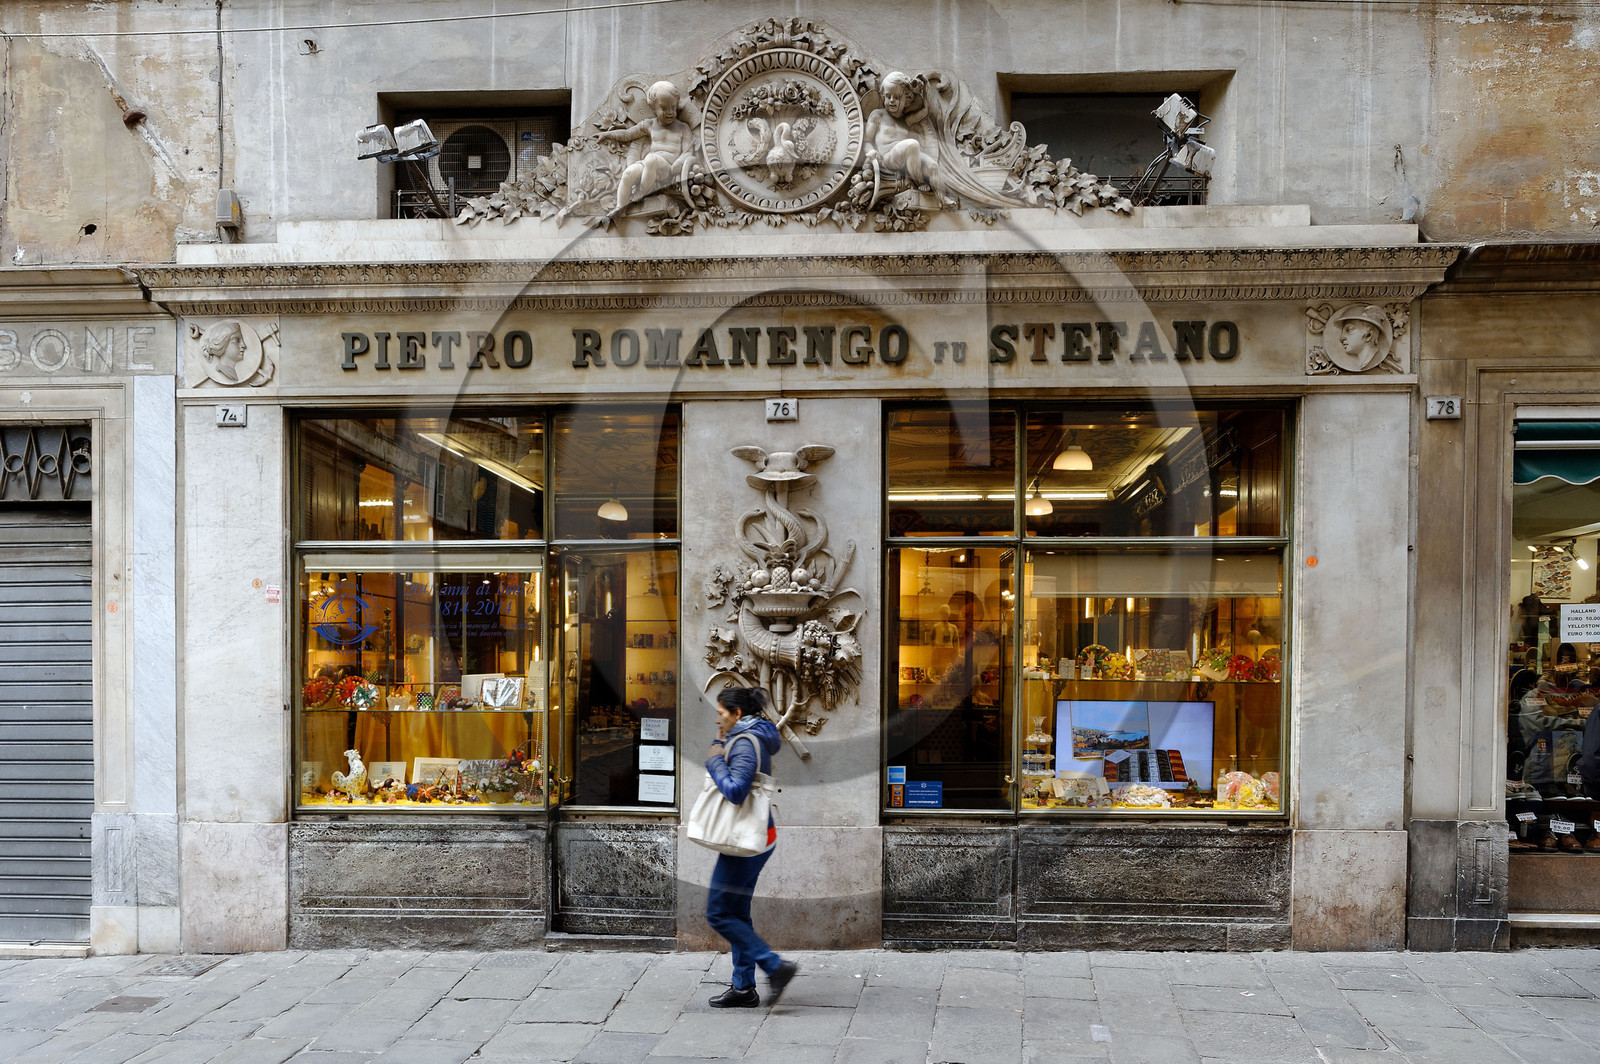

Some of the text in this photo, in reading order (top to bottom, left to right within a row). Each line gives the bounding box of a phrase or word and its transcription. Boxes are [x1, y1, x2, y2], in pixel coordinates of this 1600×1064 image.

[341, 320, 1240, 370] PIETRO ROMANENGO FU STEFANO
[221, 408, 237, 422] 74
[772, 403, 790, 417] 76
[1436, 400, 1455, 415] 78
[405, 581, 433, 596] 200
[438, 581, 470, 596] anni
[475, 580, 491, 596] di
[435, 600, 513, 616] 1814-2014
